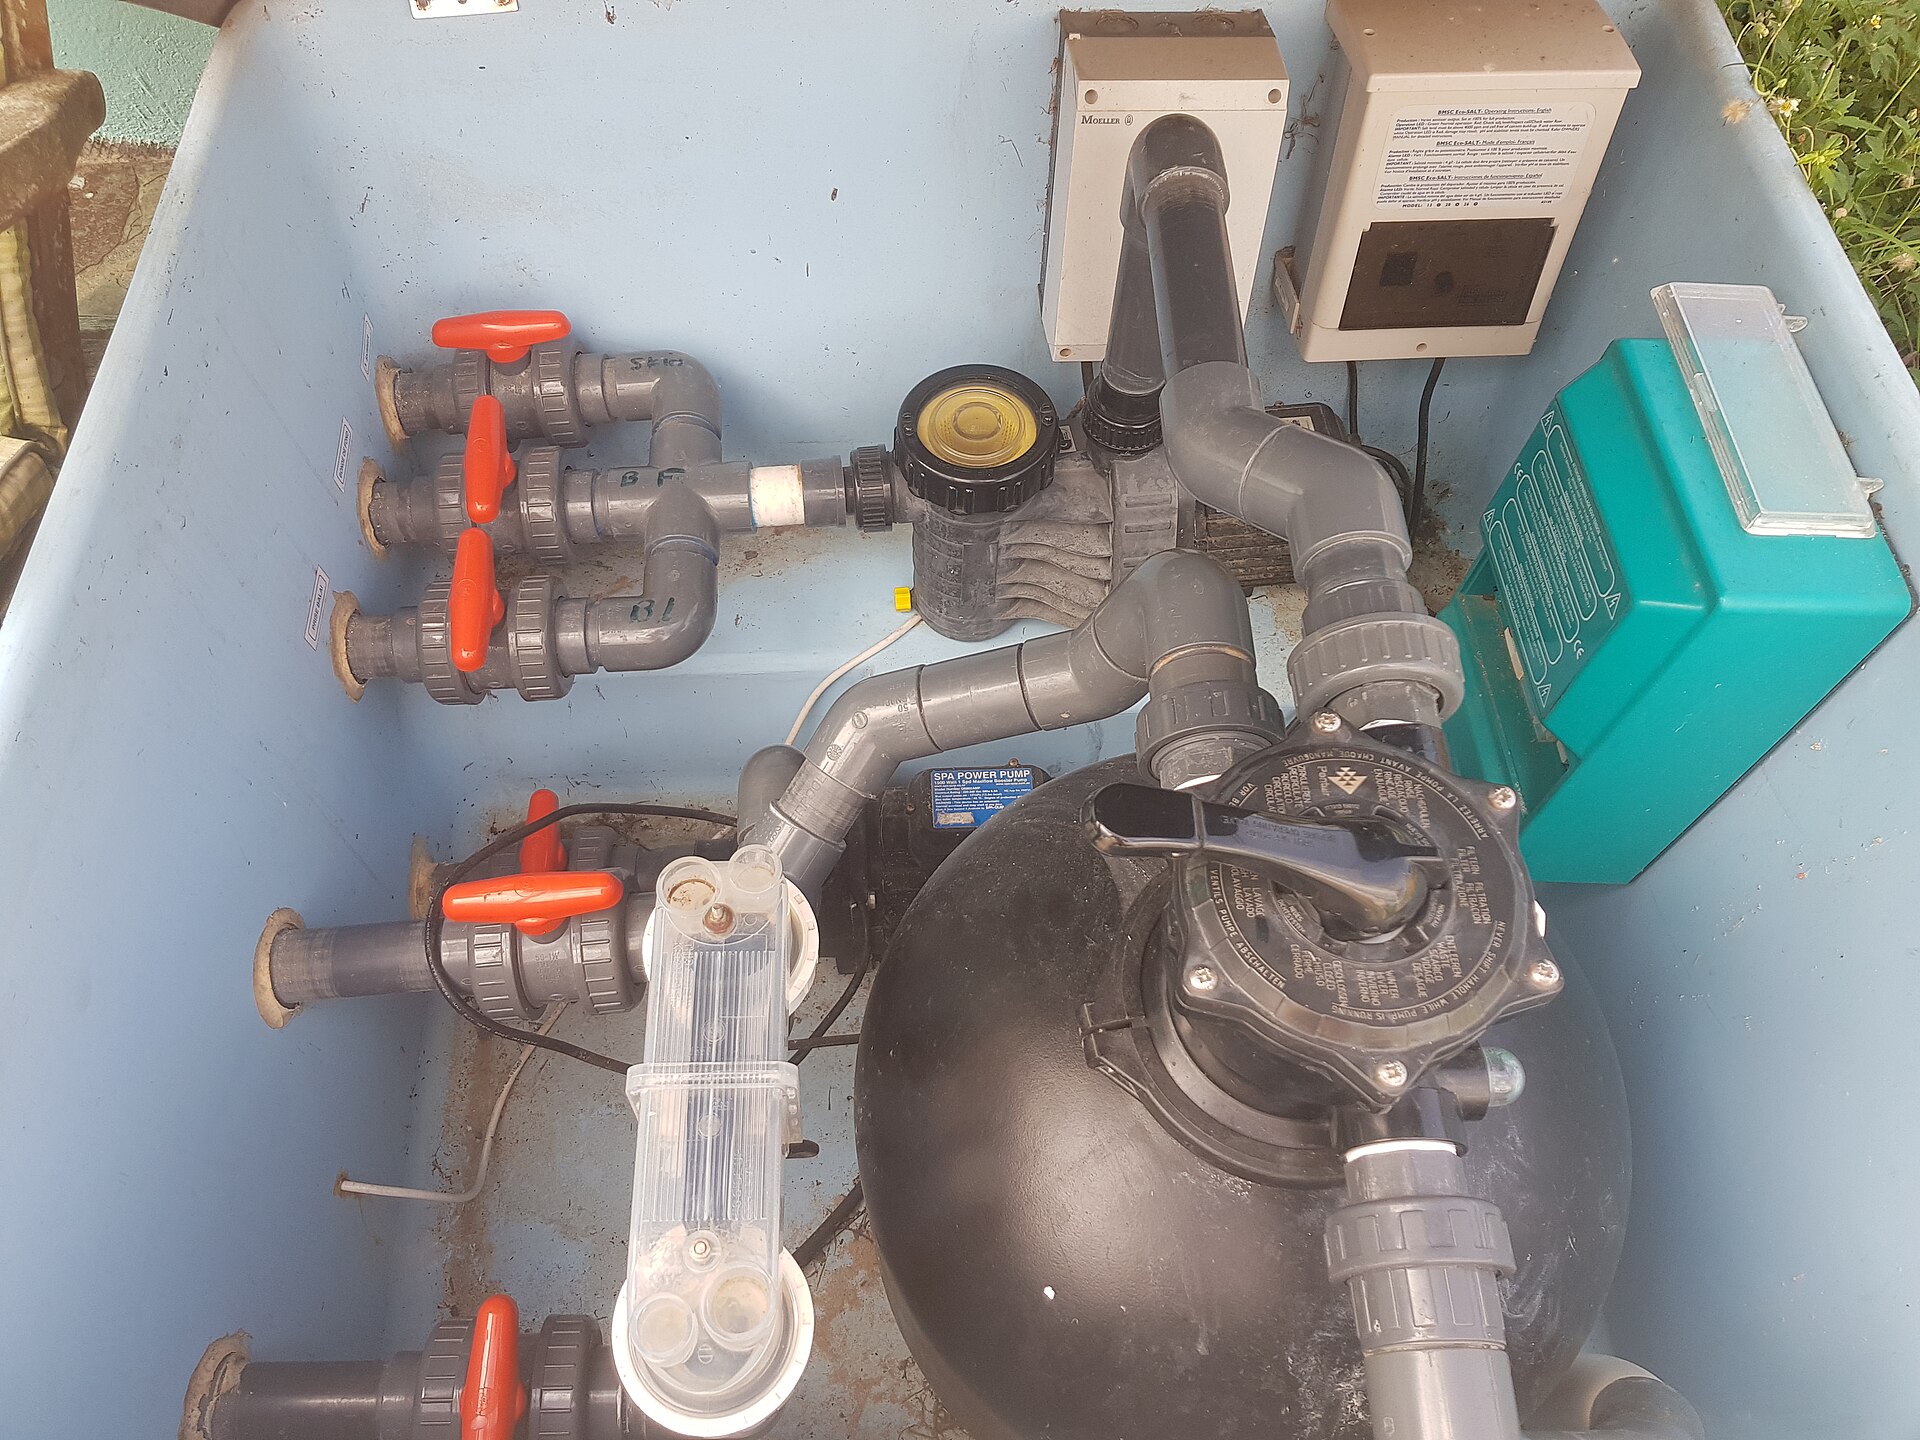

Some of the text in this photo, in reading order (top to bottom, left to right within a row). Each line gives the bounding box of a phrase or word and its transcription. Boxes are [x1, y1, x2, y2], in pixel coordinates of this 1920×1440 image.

[620, 468, 686, 487] B F
[1340, 750, 1374, 761] CHAQUE
[1380, 757, 1412, 772] AVANT
[934, 770, 1030, 781] SPA POWER PUMP
[1289, 767, 1304, 808] RECIRCULATE
[1416, 771, 1444, 792] POMPE
[1238, 782, 1255, 797] VOR
[1446, 792, 1459, 804] LA
[1450, 857, 1470, 908] FILTRAZIONE
[1457, 848, 1483, 925] FILTER FILTRACION
[1466, 846, 1492, 925] FILTERN FILTRATION
[1242, 887, 1256, 918] LAVADO
[1252, 888, 1266, 917] LAVAGE
[1210, 869, 1286, 990] VENTILS PUMPE ABSCHALTEN
[1492, 920, 1506, 948] NEVER
[1290, 943, 1304, 979] CERRADO
[1429, 948, 1444, 982] SCARICO
[1438, 941, 1450, 968] WASTE
[1480, 951, 1496, 974] SHIFT
[1412, 962, 1428, 998] DESAGUE
[1422, 956, 1435, 984] VIDAGE
[1356, 969, 1370, 1004] INVERNO
[1378, 972, 1389, 996] HIVER
[1387, 970, 1400, 1000] WINTER
[1450, 974, 1480, 1000] HANDLE
[1374, 1013, 1386, 1021] IS
[1392, 1011, 1418, 1023] PUMP
[1420, 998, 1450, 1014] WHILE
